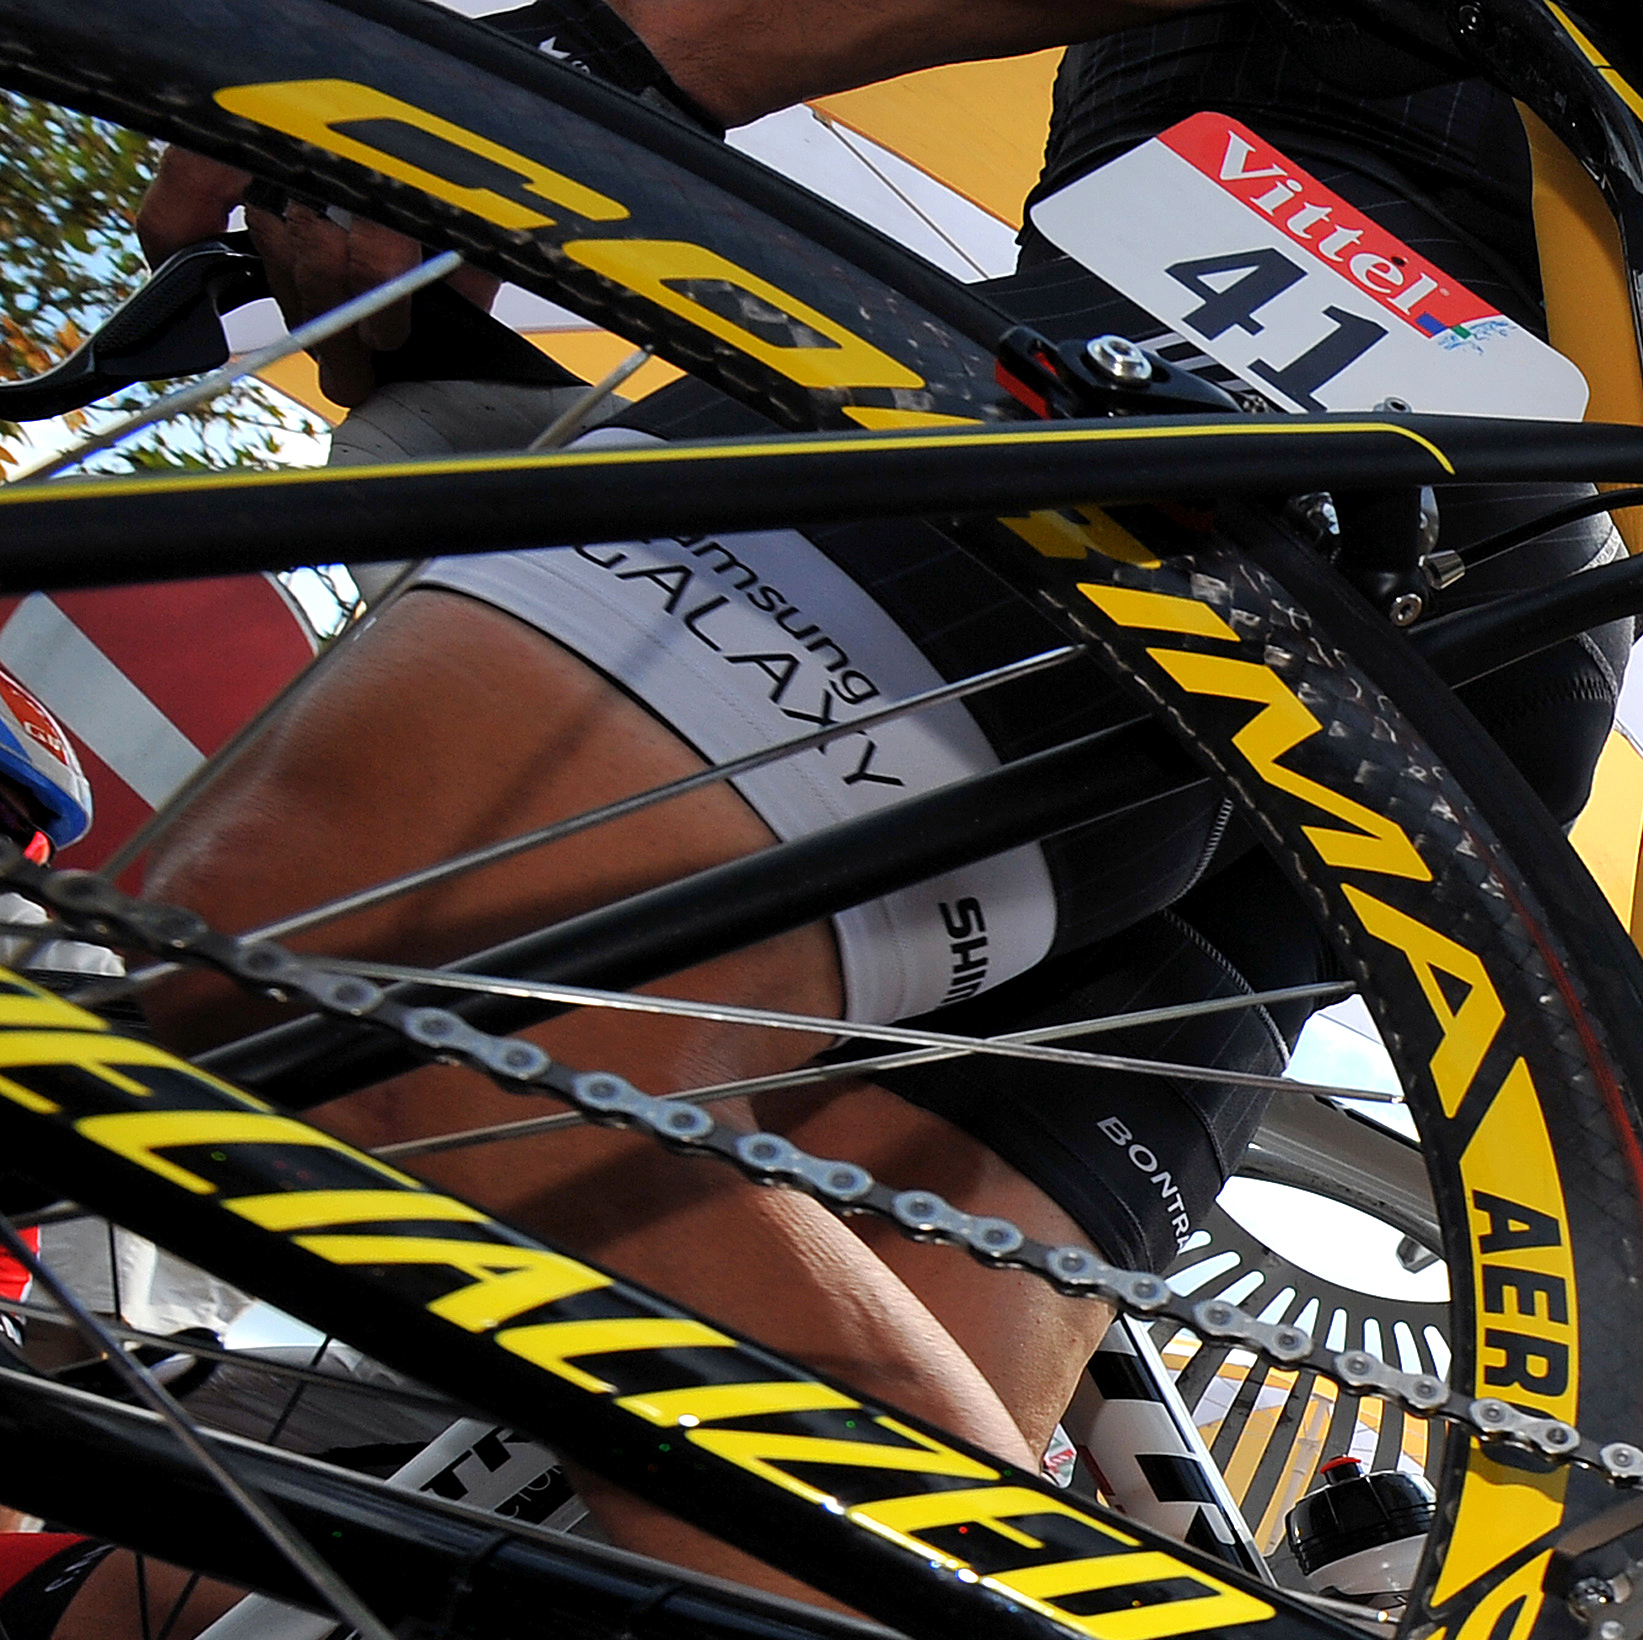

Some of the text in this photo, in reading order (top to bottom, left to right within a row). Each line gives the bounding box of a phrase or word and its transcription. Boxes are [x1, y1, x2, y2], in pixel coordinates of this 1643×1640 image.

[1217, 129, 1446, 317] Vittel
[1163, 246, 1390, 413] 41
[213, 77, 1506, 1118] COIMA
[660, 532, 880, 703] amsung
